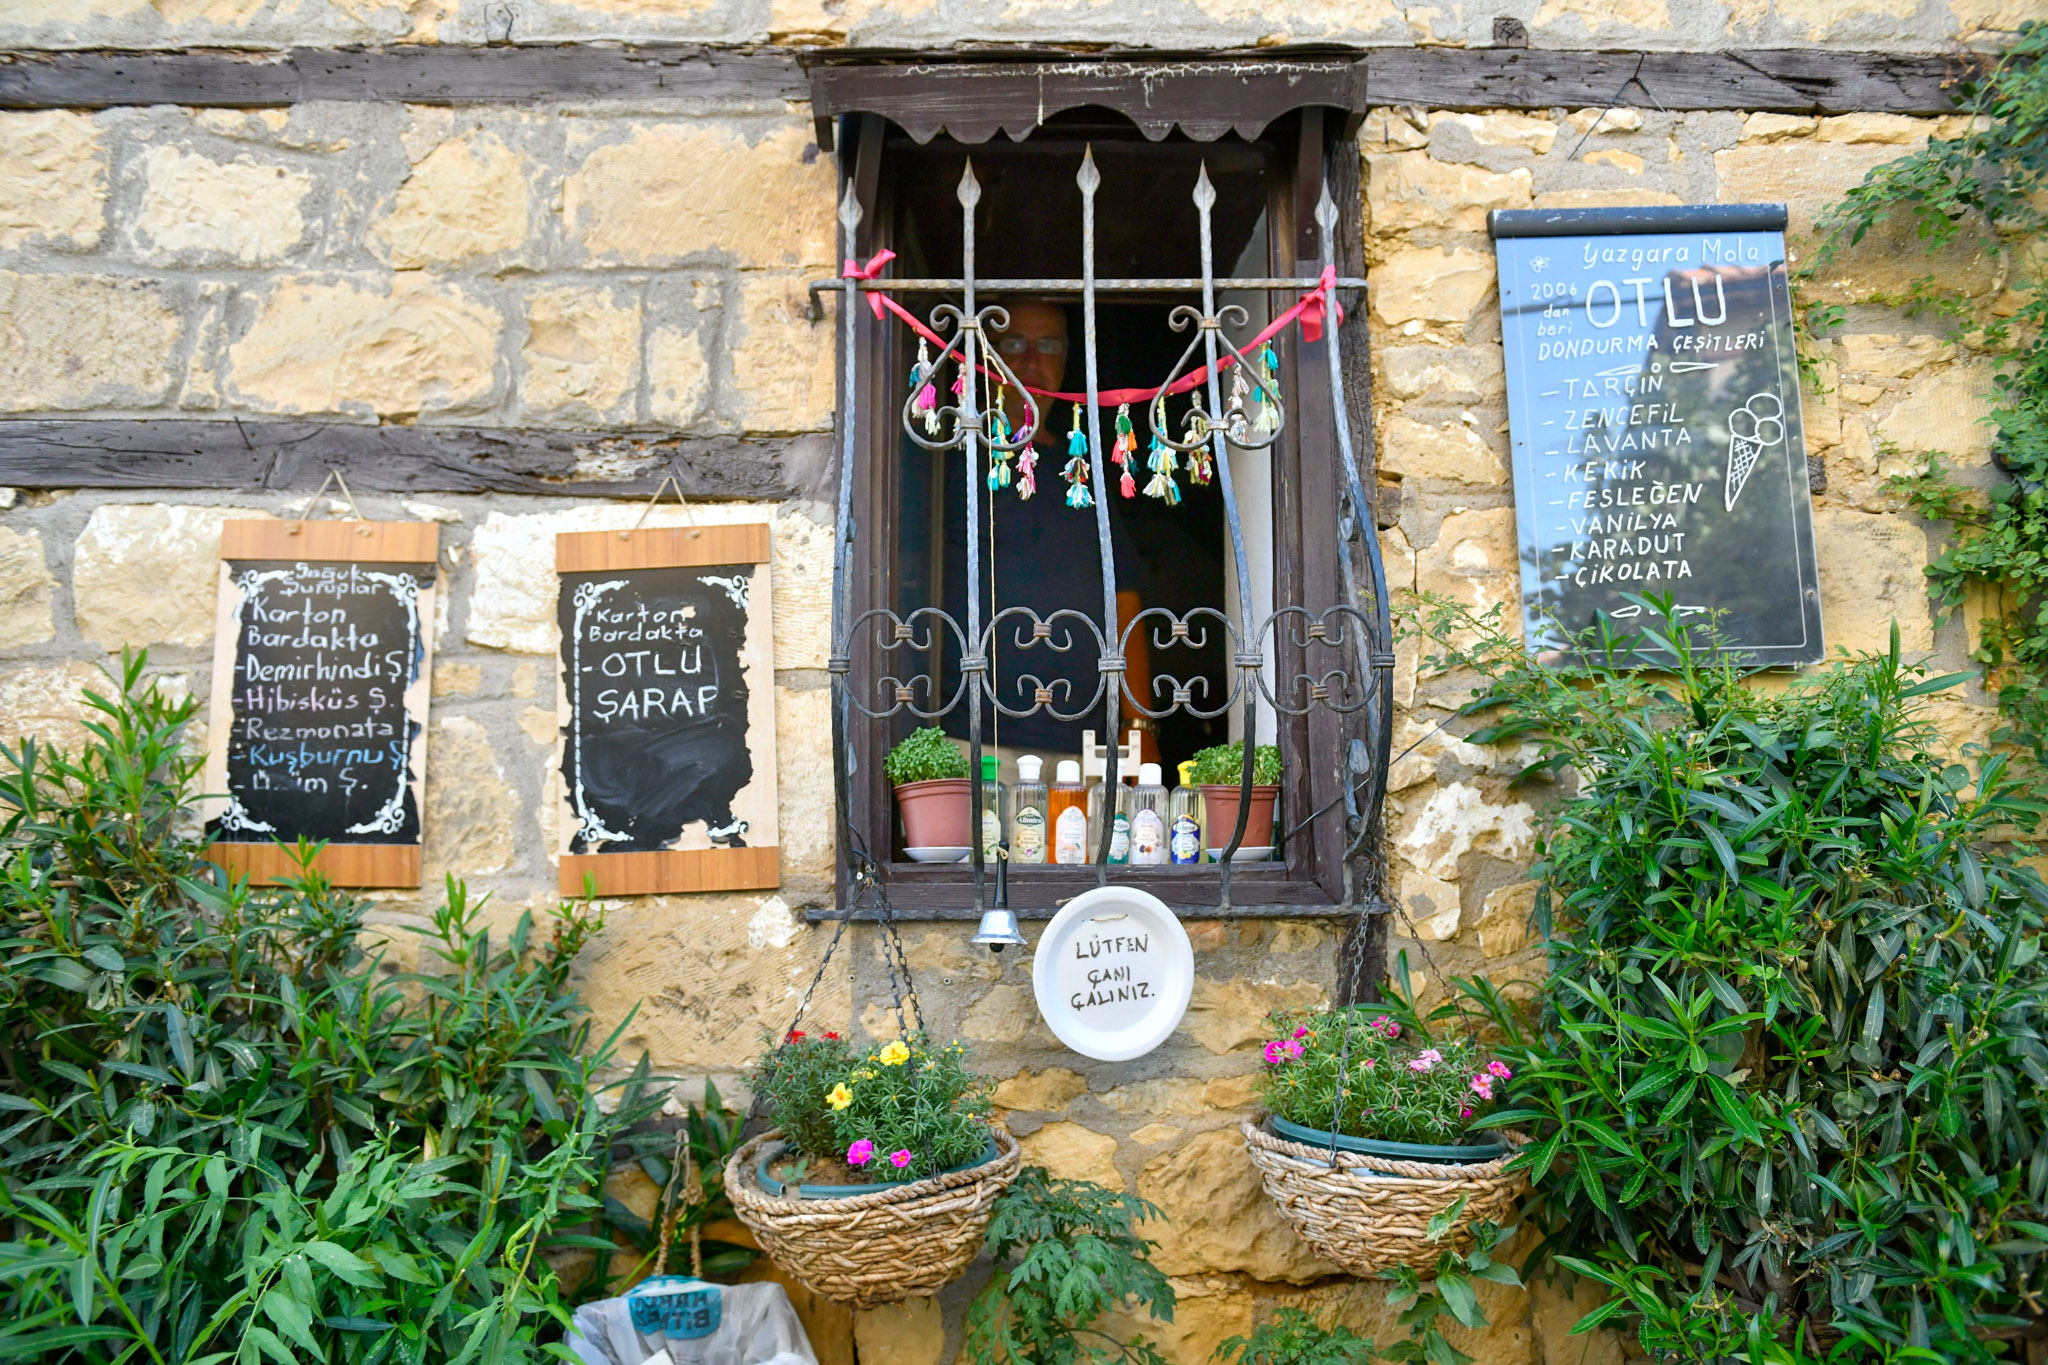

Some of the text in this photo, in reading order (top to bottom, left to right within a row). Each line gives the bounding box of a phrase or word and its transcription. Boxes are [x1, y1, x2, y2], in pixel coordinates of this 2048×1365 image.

[1701, 237, 1759, 263] Mola
[1531, 282, 1578, 301] 2006
[1586, 274, 1727, 328] OTLU
[1543, 303, 1570, 319] dan
[1537, 321, 1572, 337] beri
[1538, 334, 1659, 362] DONDURMA
[1563, 375, 1663, 400] TARÇIN
[1565, 403, 1684, 431] ZENCEFİL
[1566, 427, 1691, 455] LAVANTA
[1564, 458, 1646, 483] KEKİK
[1568, 480, 1703, 510] FESLEĞEN
[1570, 512, 1677, 535] VANİLYA
[1569, 532, 1685, 561] KARADUT
[1575, 559, 1692, 588] ÇİKOLATA
[252, 597, 347, 625] Karton
[597, 604, 685, 624] Karton
[248, 625, 379, 649] Bardakta
[589, 622, 704, 643] Bardakta
[602, 645, 702, 678] OTLU
[246, 685, 359, 713] Hibisküs
[593, 685, 719, 723] ŞARAP
[1076, 933, 1149, 960] LÜTFEN
[1087, 966, 1131, 989] ÇANI
